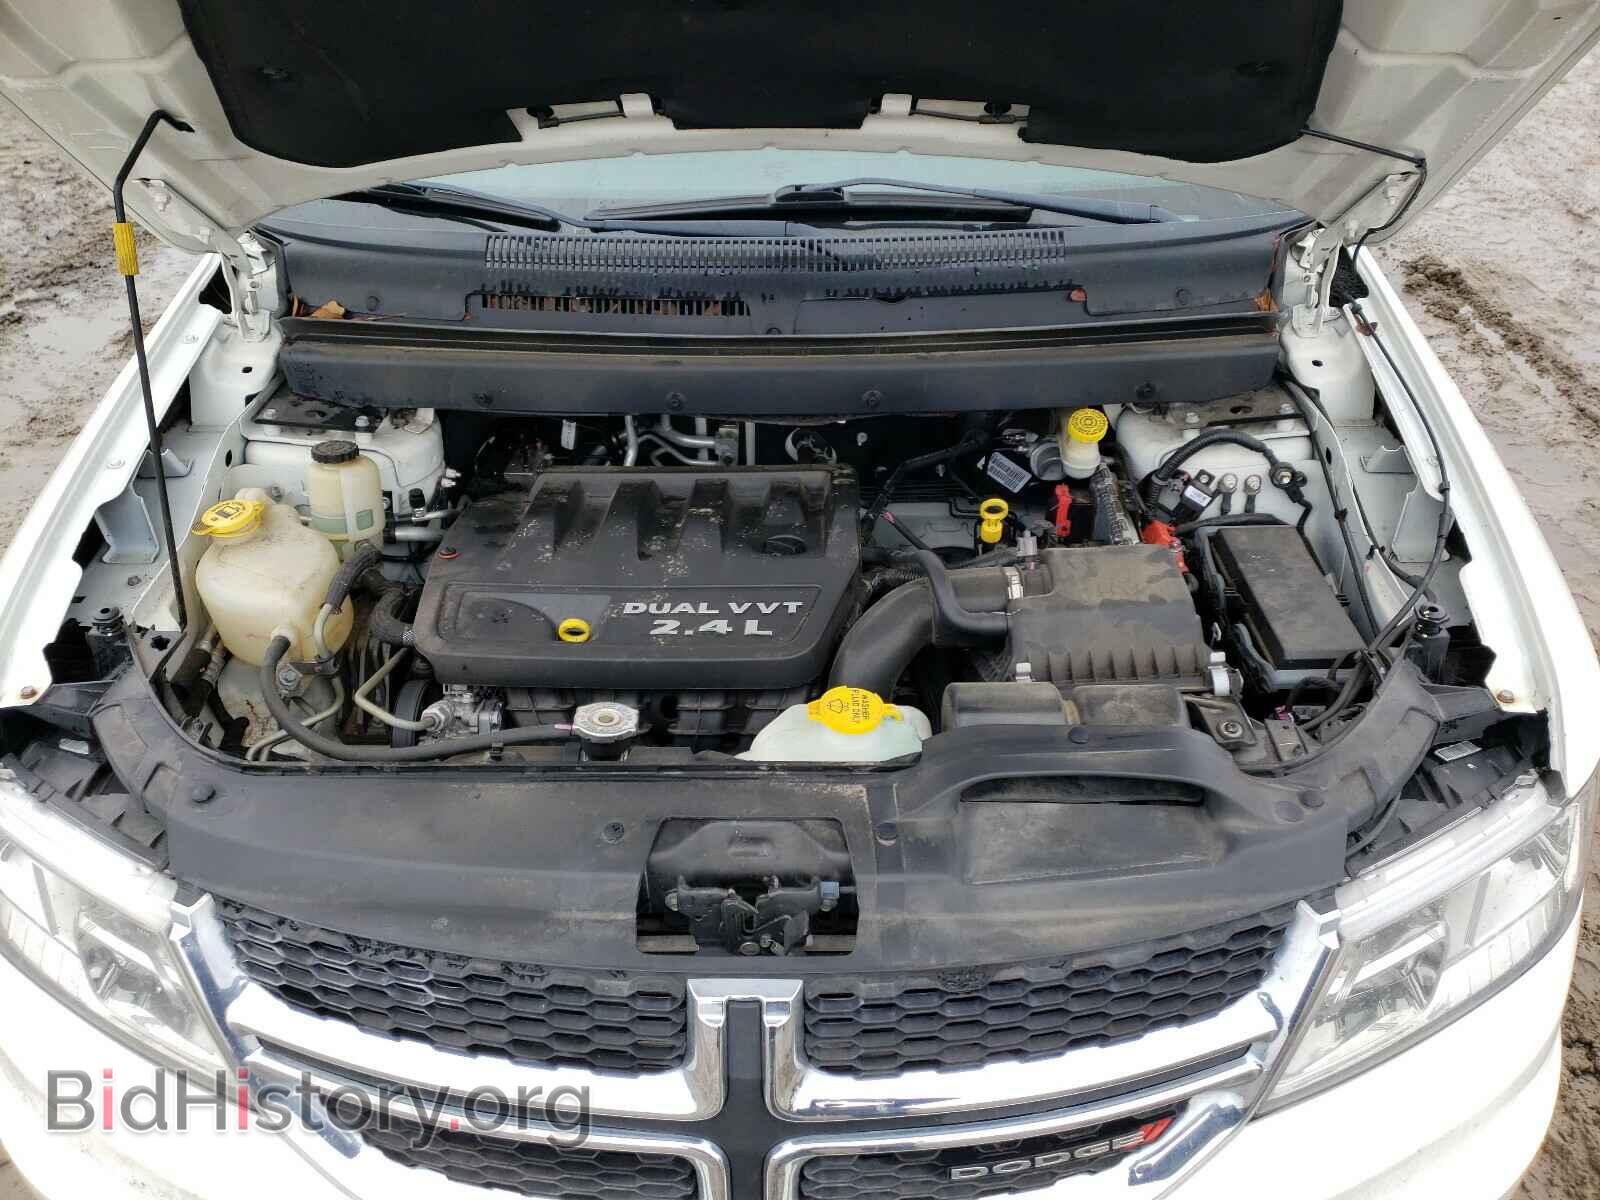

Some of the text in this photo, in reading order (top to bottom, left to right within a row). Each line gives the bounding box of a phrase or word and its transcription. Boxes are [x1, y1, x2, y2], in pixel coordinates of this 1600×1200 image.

[622, 601, 804, 614] DUAL VVT
[950, 1130, 1145, 1180] DODGE
